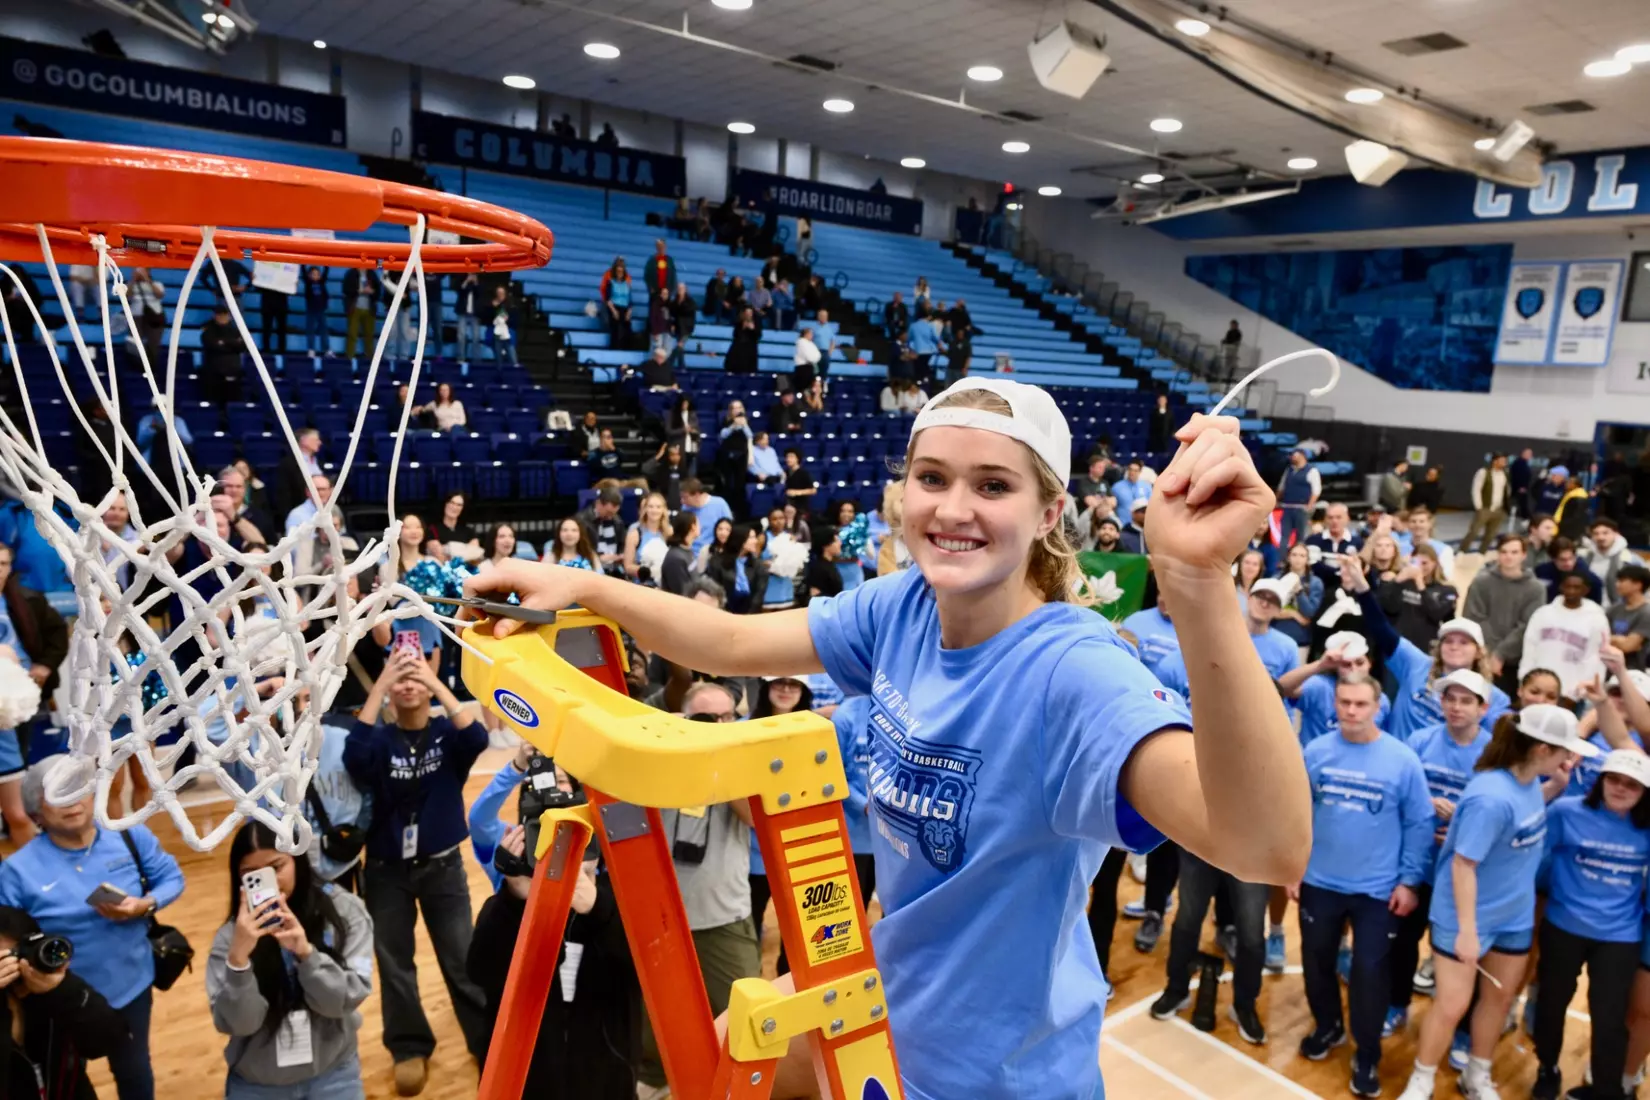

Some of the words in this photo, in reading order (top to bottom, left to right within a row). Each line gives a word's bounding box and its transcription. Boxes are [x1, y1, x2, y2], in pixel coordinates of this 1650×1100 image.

[12, 58, 38, 83] @
[44, 65, 307, 126] GOCOLUMBIALIONS
[454, 128, 655, 187] COLUMBIA
[501, 694, 531, 721] WERNER
[873, 713, 893, 734] 2025
[914, 754, 964, 772] BASKETBALL
[820, 900, 844, 910] CAPACITY
